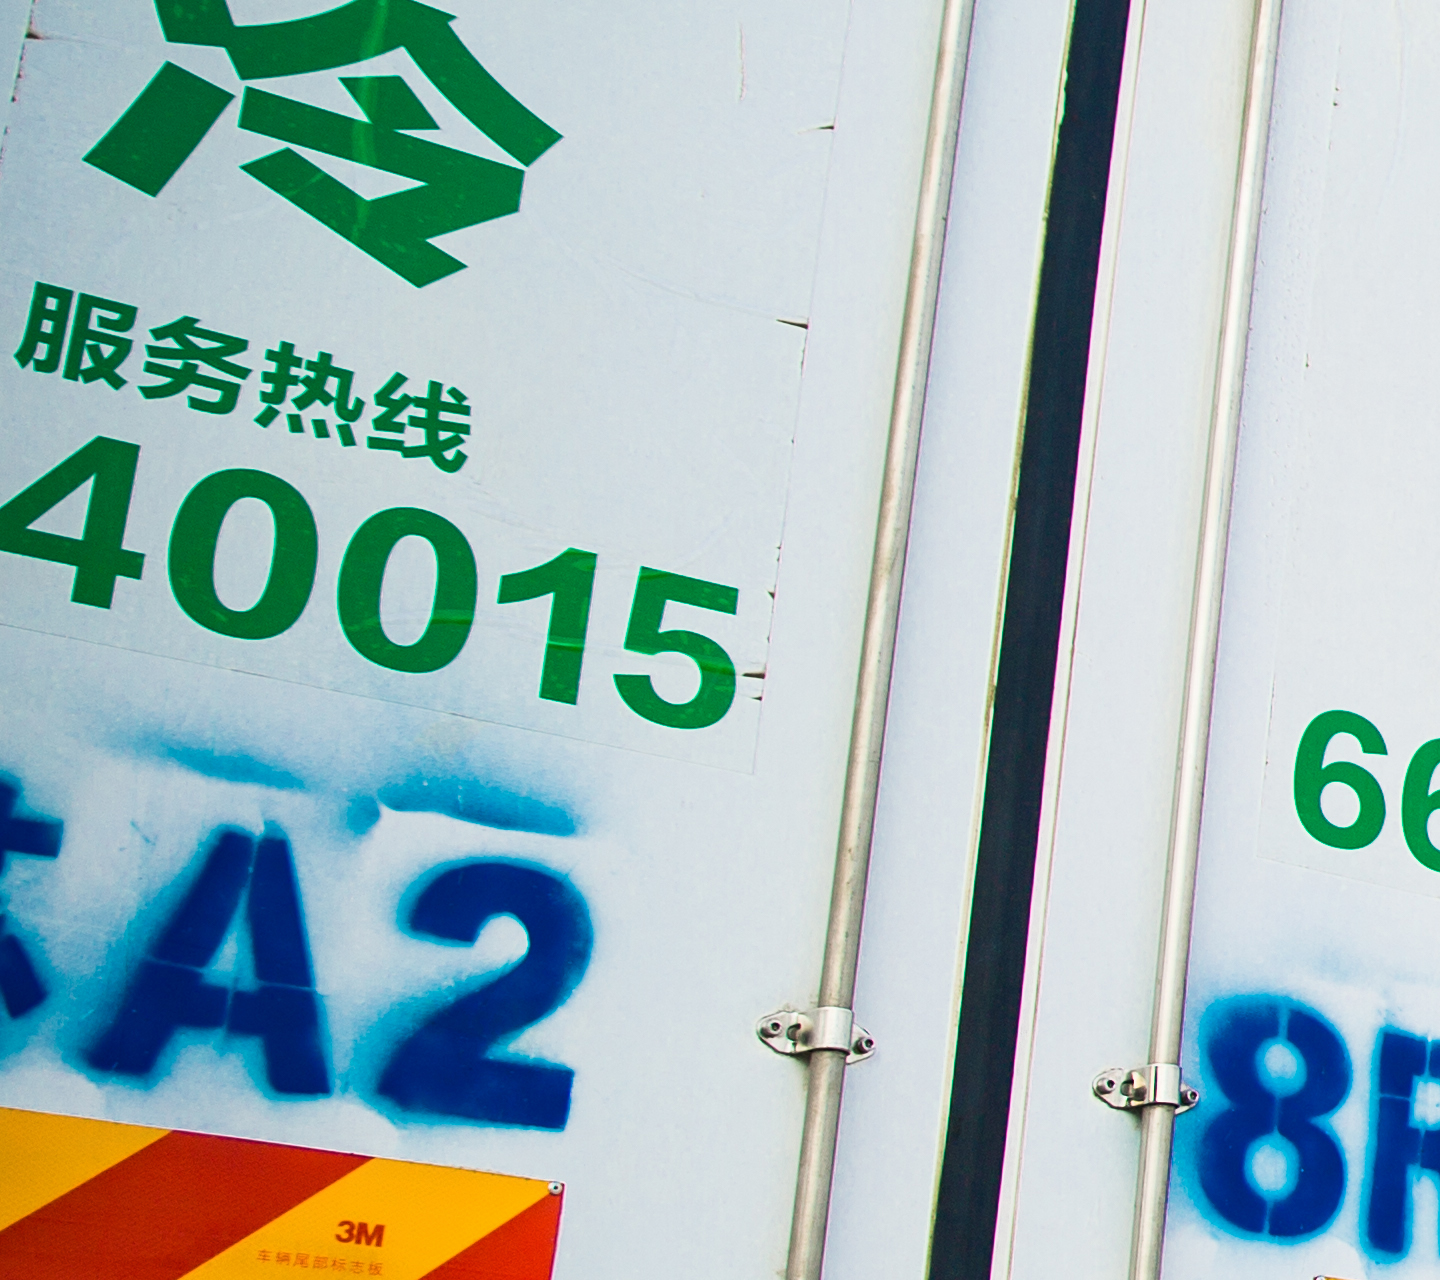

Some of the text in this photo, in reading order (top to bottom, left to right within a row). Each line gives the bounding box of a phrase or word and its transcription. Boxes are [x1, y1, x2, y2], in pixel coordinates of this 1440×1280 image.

[13, 281, 473, 473] 服务热线
[0, 435, 740, 730] 40015
[256, 1250, 384, 1277] 车辆尾部标志板
[336, 1220, 386, 1248] 3M
